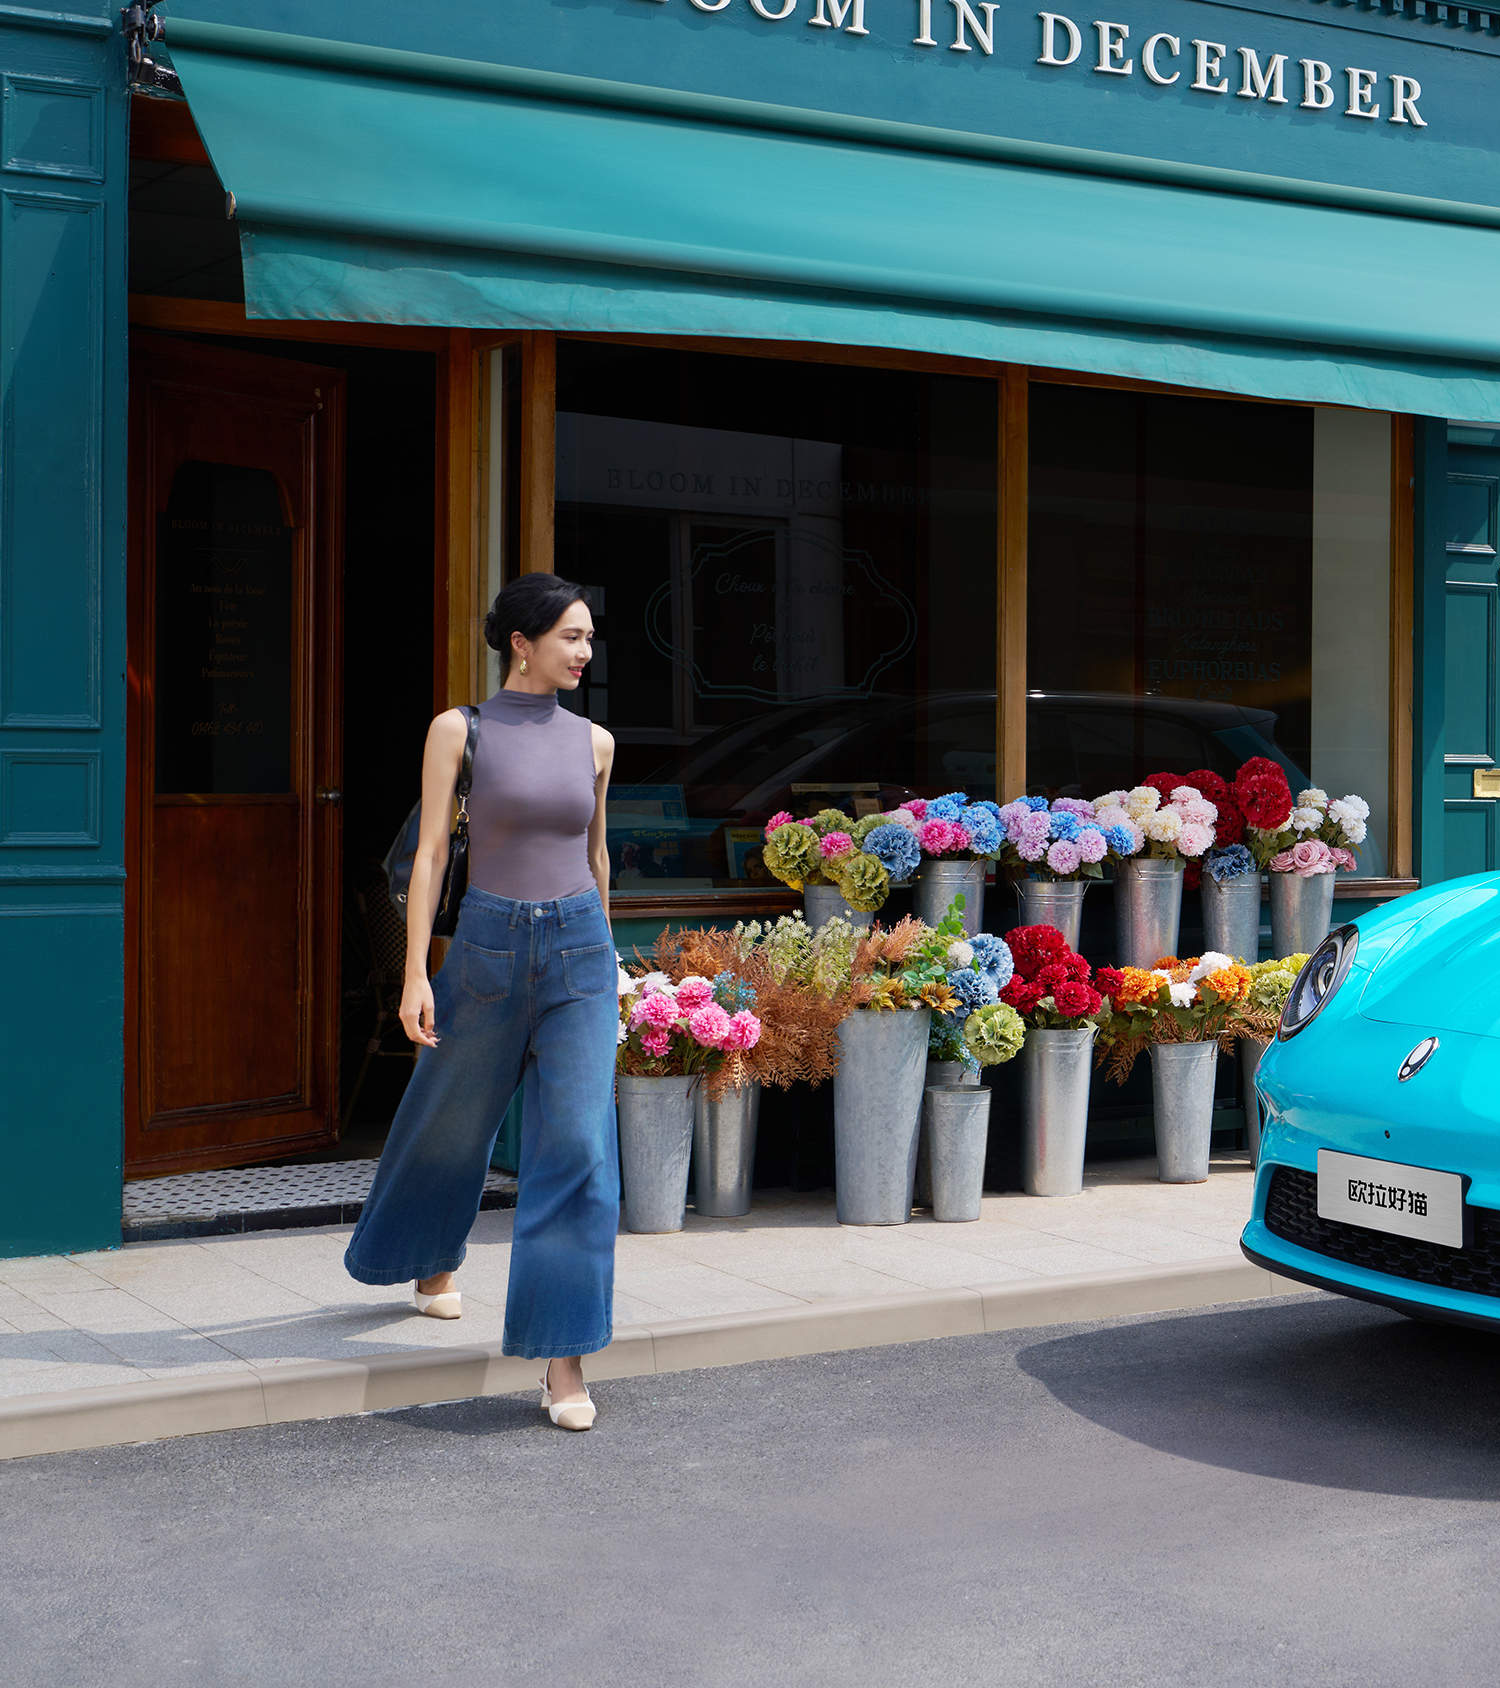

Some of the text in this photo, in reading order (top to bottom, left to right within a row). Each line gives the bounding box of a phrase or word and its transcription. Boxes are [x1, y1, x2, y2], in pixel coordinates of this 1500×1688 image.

[912, 0, 1000, 55] IN
[1036, 11, 1428, 127] DECEMBER
[1347, 1178, 1428, 1217] 欧拉好猫
